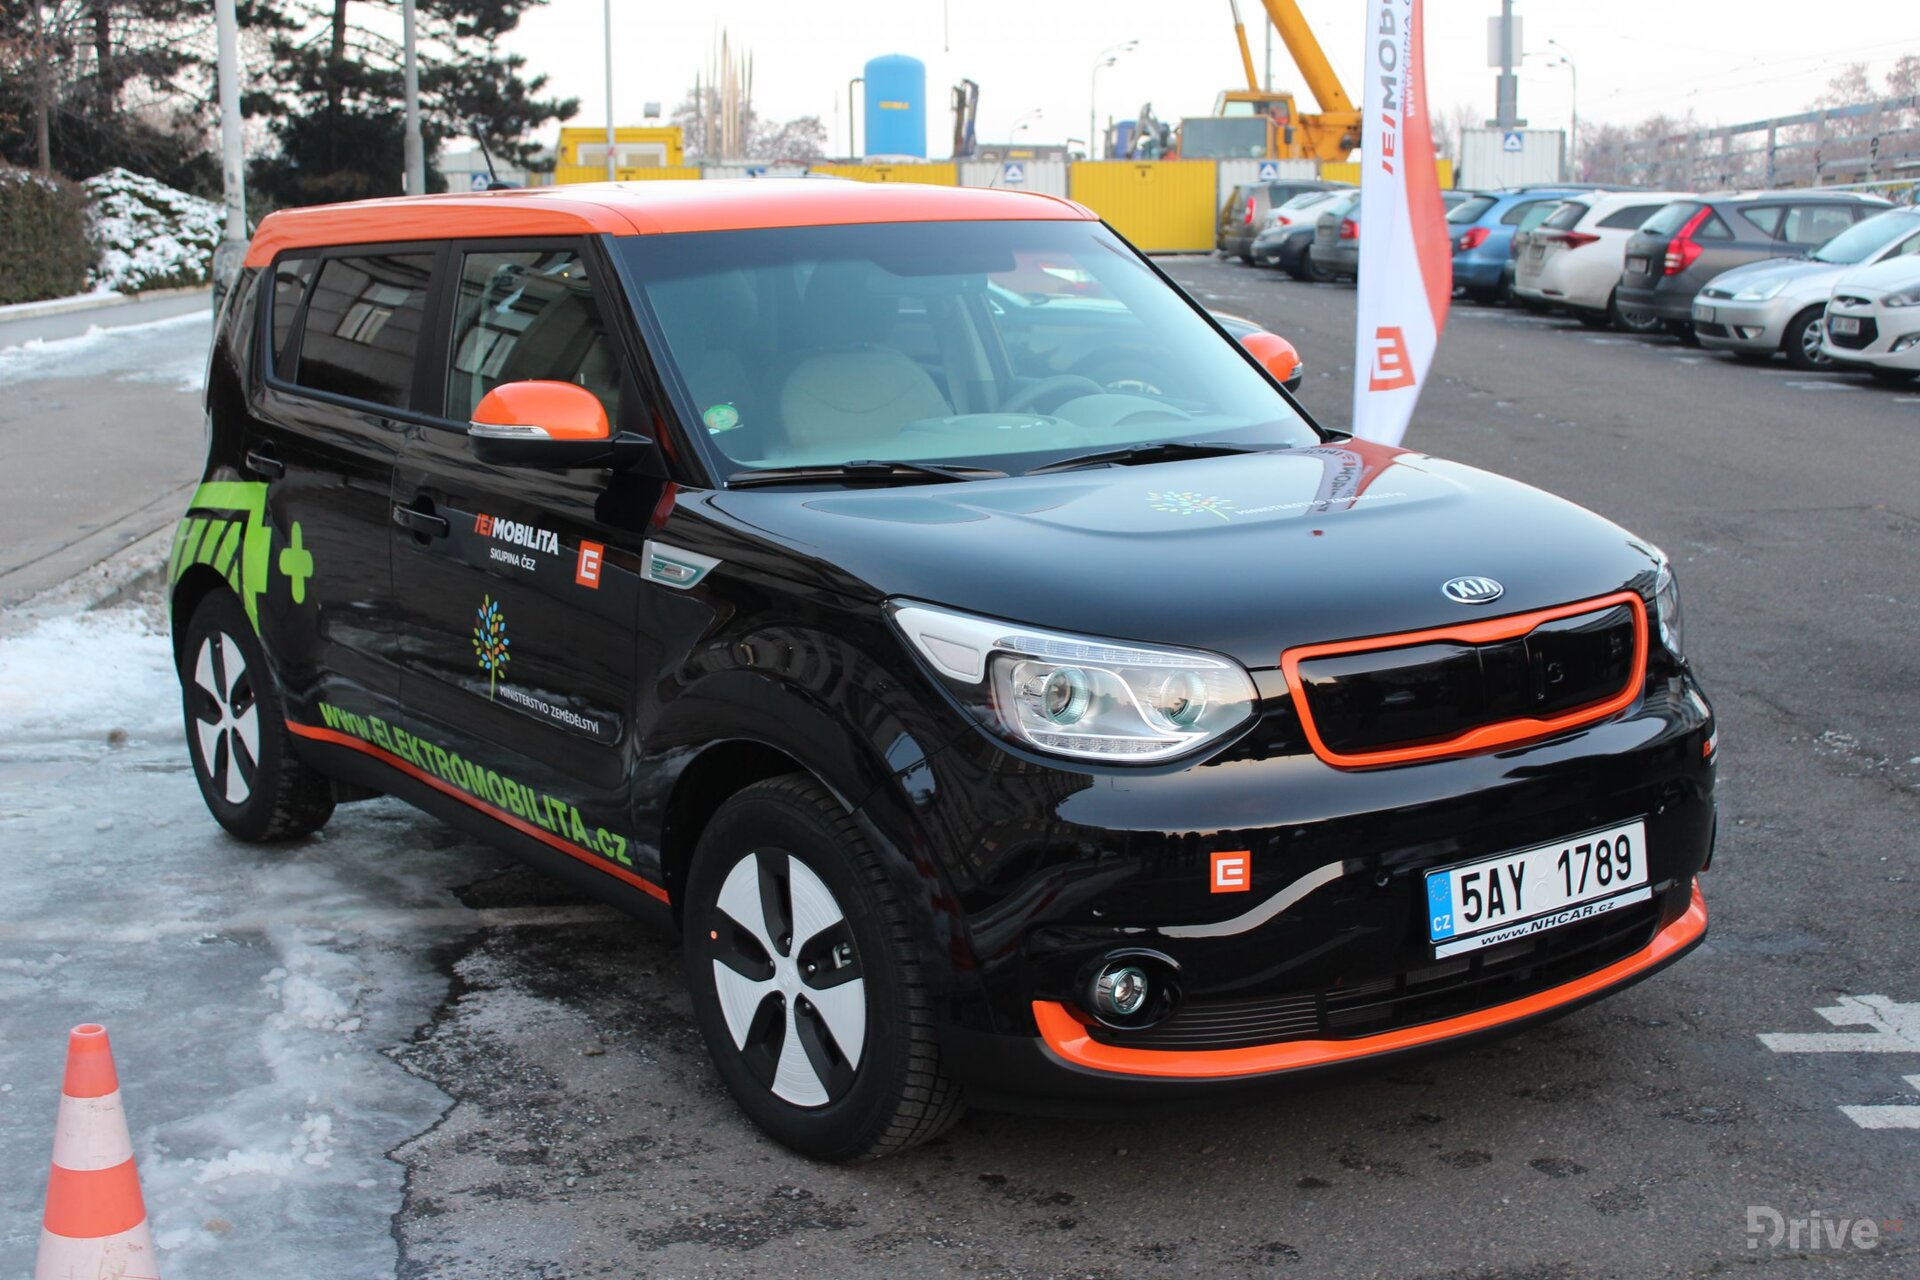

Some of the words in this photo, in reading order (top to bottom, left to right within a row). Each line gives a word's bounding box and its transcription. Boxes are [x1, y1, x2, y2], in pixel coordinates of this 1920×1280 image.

[489, 547, 520, 567] SKUPINA
[520, 553, 536, 571] ČEZ
[1449, 579, 1499, 598] KIA
[500, 686, 549, 714] MINISTERSTVO
[550, 705, 599, 734] ZEMĚDĚLSTVÍ
[1460, 860, 1526, 924] 5AY
[1557, 833, 1632, 898] 1789
[1432, 914, 1452, 932] CZ
[1480, 901, 1615, 946] www.NHCAR.cz
